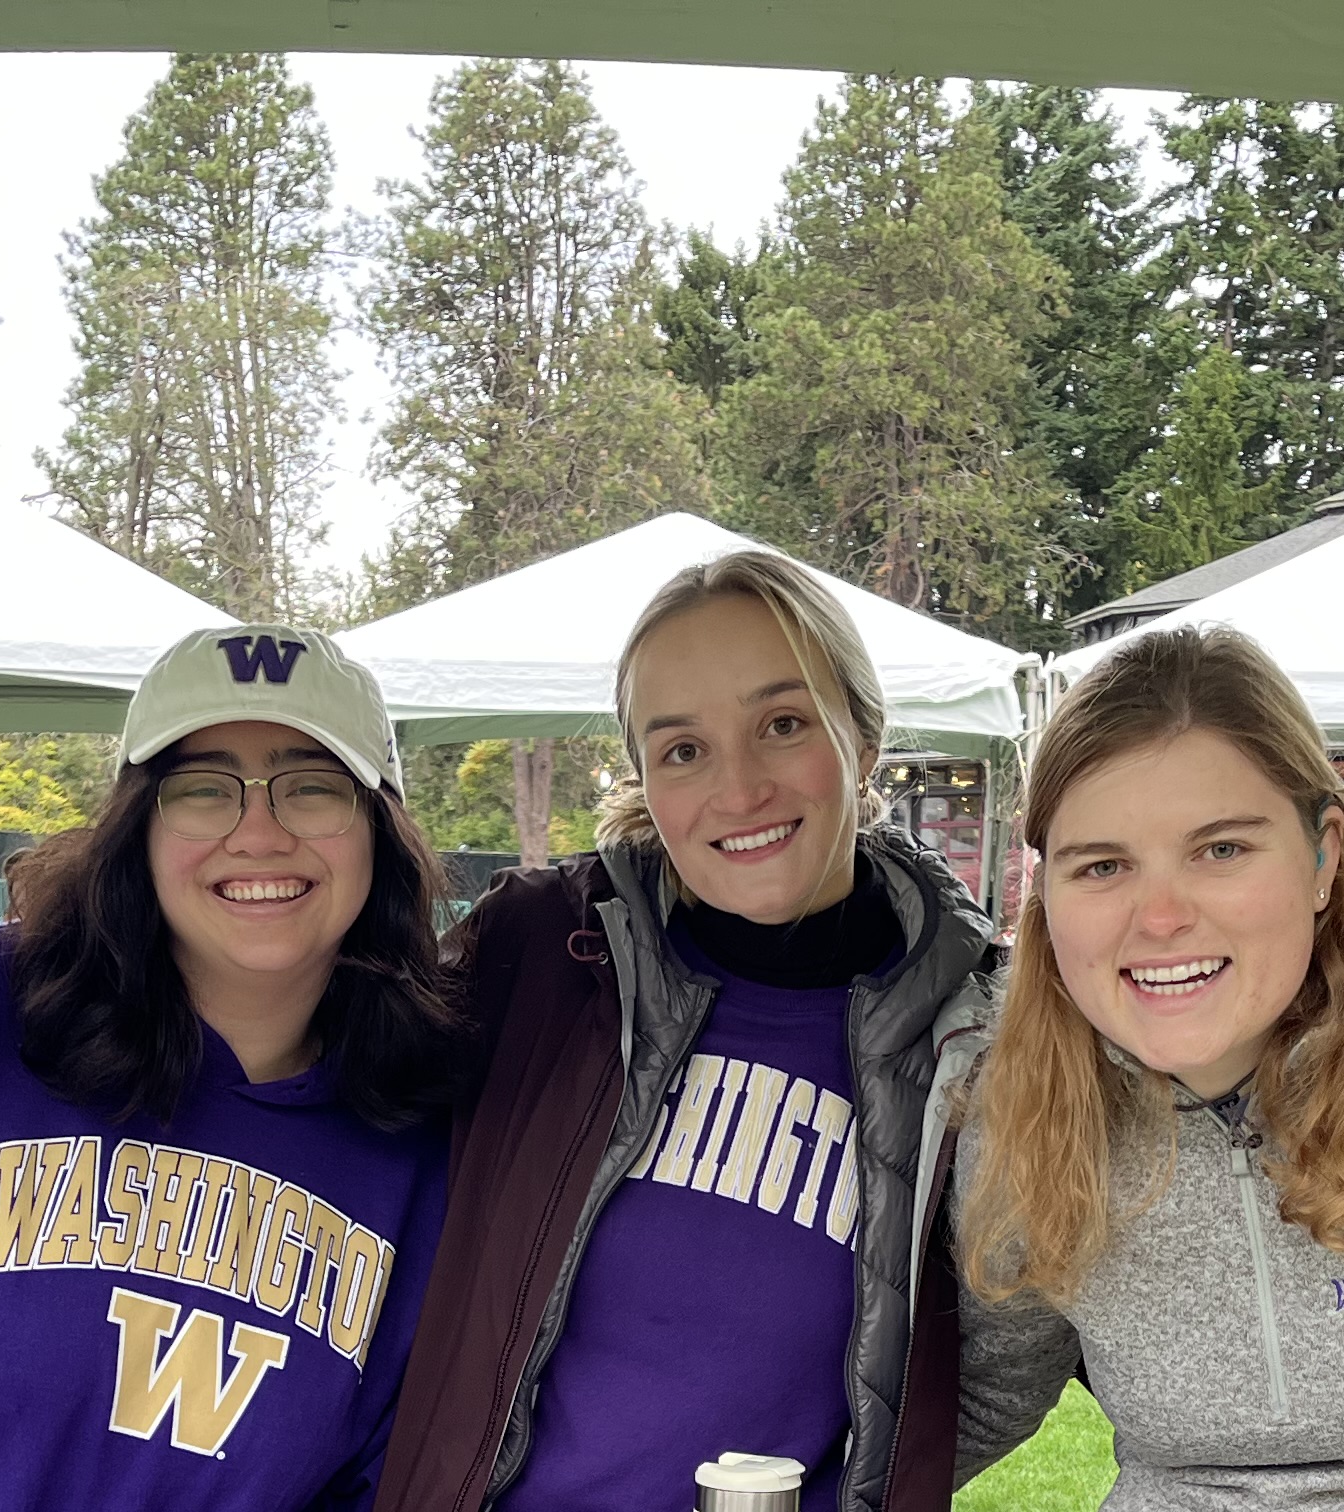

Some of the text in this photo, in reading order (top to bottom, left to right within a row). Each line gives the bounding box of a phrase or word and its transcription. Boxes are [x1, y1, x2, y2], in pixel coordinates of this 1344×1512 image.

[217, 635, 307, 683] W
[626, 1054, 860, 1252] HINGTO
[107, 1287, 290, 1457] W
